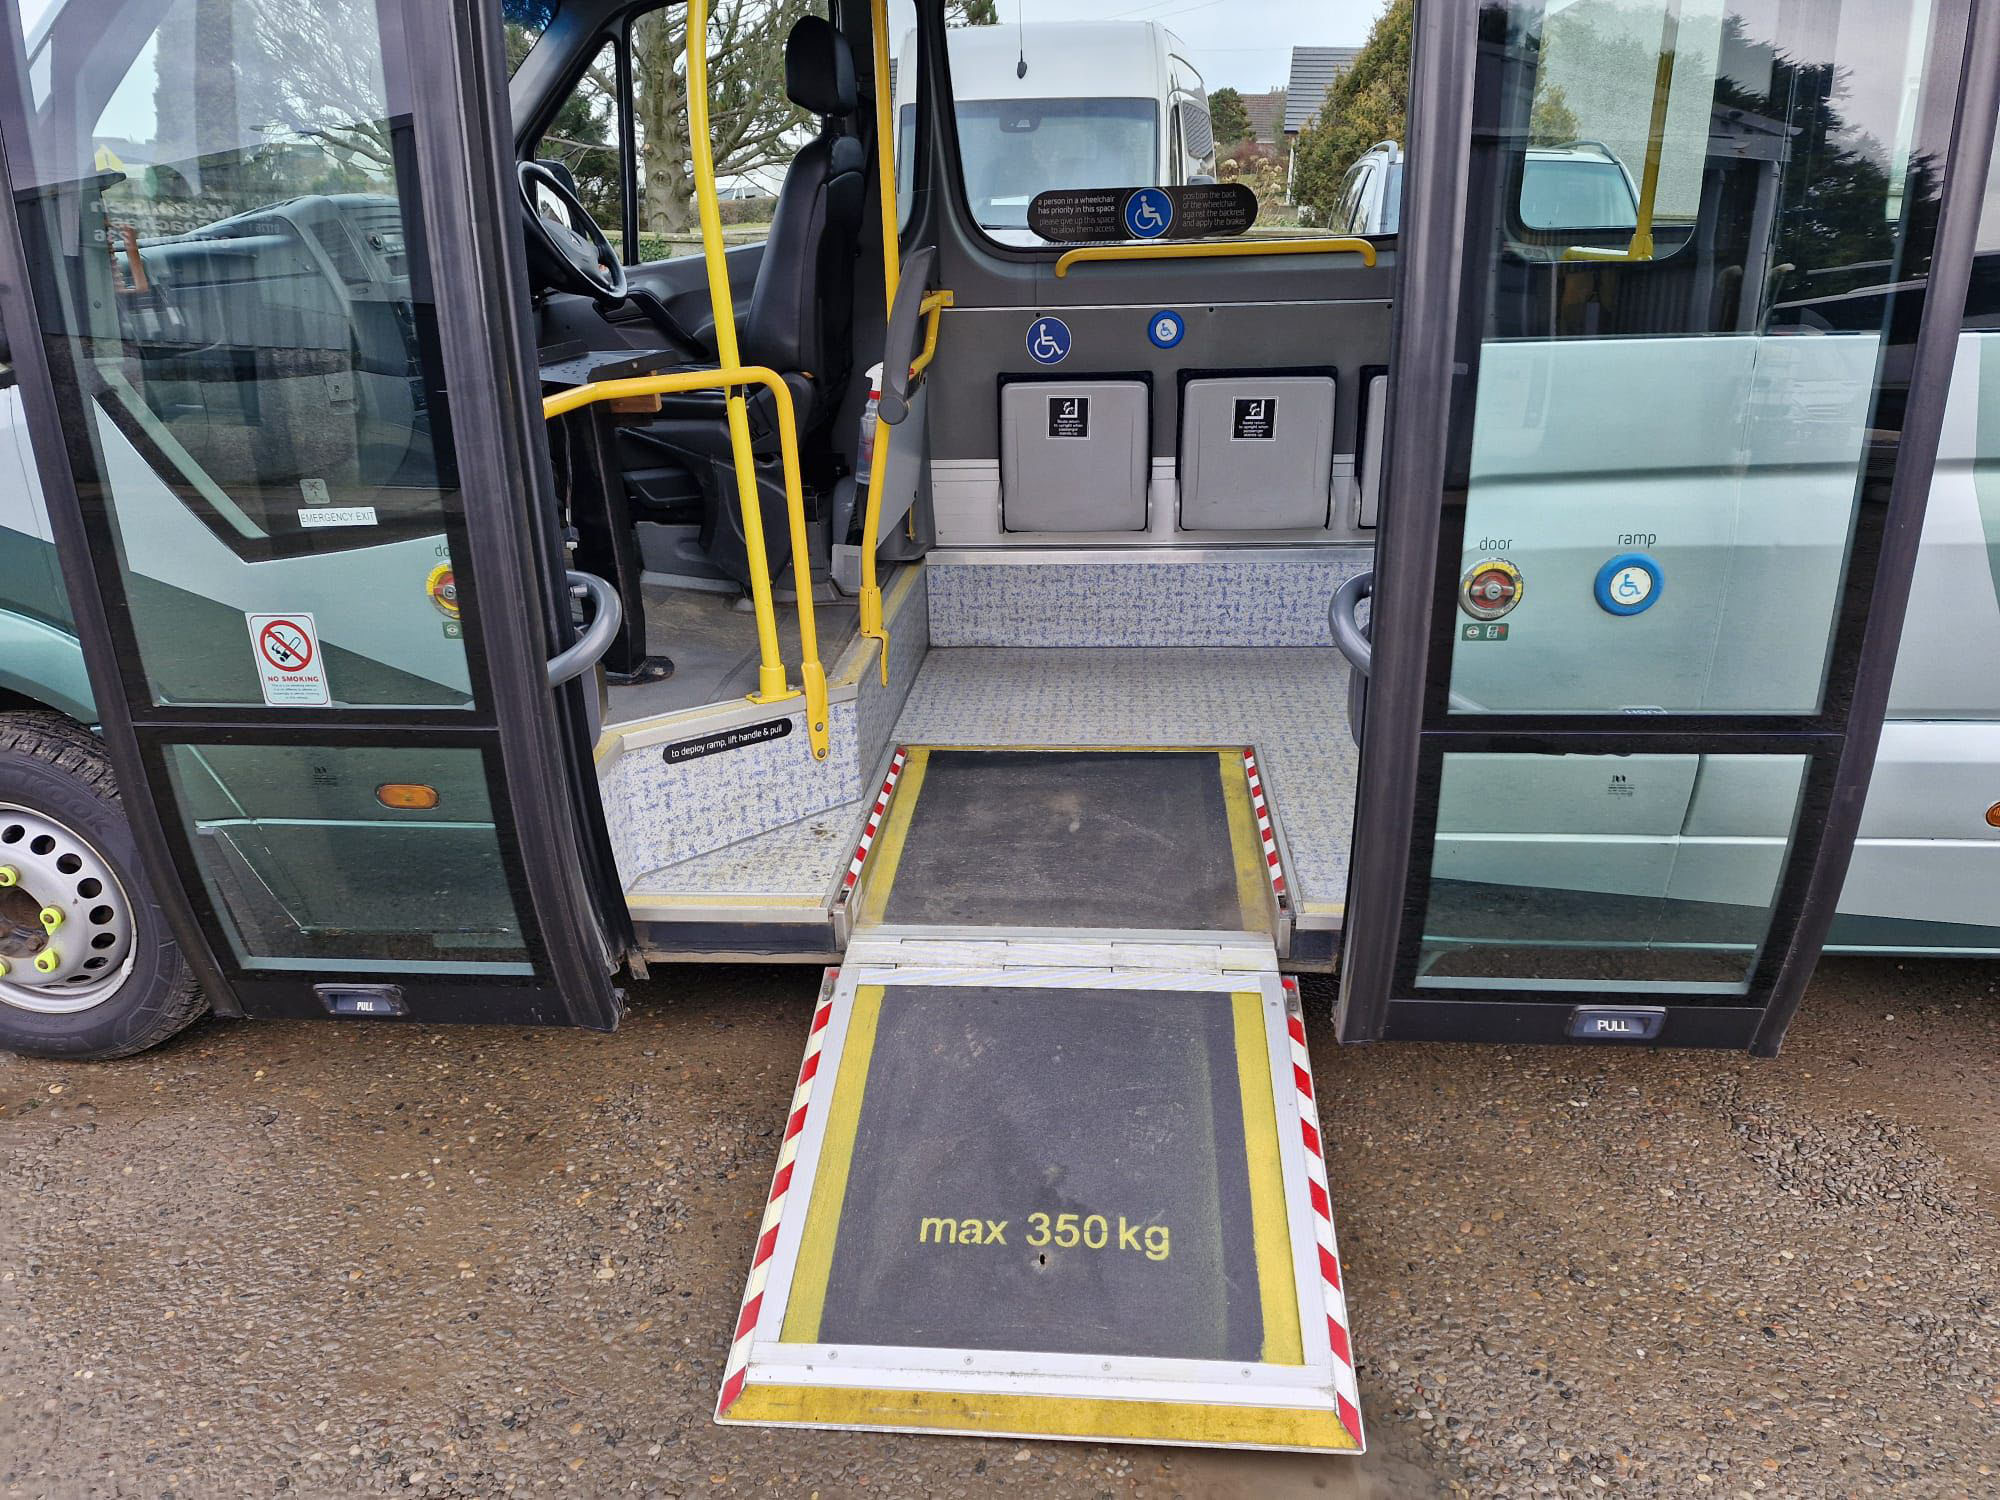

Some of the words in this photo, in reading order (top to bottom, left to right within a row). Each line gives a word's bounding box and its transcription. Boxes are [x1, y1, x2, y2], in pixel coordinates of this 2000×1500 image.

[1222, 190, 1237, 198] back
[1044, 198, 1066, 208] person
[1067, 196, 1074, 204] in
[1080, 195, 1115, 203] wheelchair
[1202, 200, 1237, 208] wheelchair
[1050, 206, 1074, 215] priority
[1082, 204, 1095, 212] this
[1096, 206, 1115, 214] space
[1220, 208, 1245, 216] backrest
[1061, 218, 1073, 226] give
[1096, 216, 1115, 224] space
[1196, 219, 1212, 228] apply
[301, 512, 353, 523] EMERGENCY
[356, 512, 374, 520] EXIT
[1479, 537, 1512, 550] door
[1618, 533, 1656, 548] ramp
[434, 544, 451, 556] do
[671, 749, 680, 758] to
[681, 744, 706, 756] deploy
[706, 740, 727, 750] ramp,
[728, 735, 738, 744] lift
[739, 730, 762, 742] handle
[763, 728, 769, 736] &
[770, 724, 782, 736] pull
[356, 1002, 374, 1011] PULL
[1597, 1020, 1630, 1032] PULL
[920, 1216, 1008, 1245] max
[1026, 1212, 1108, 1249] 350
[1119, 1216, 1169, 1261] kg
